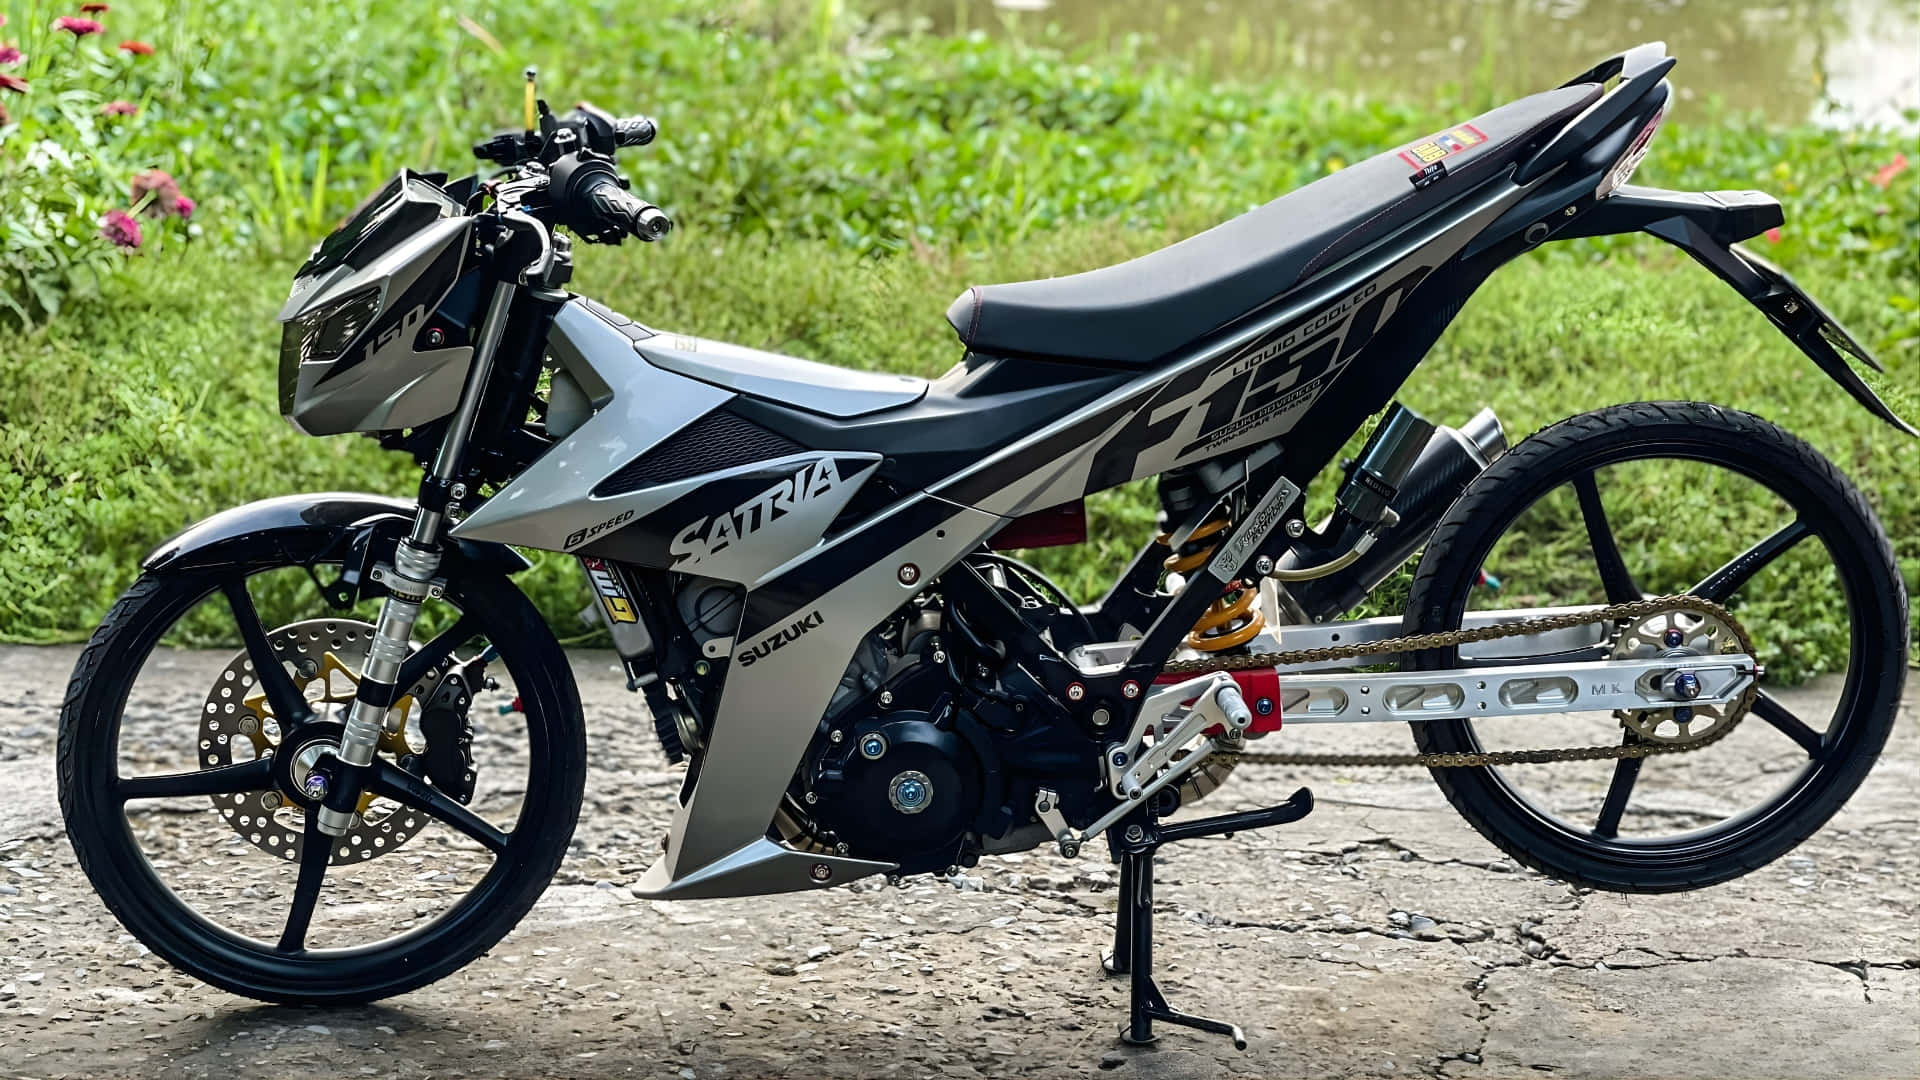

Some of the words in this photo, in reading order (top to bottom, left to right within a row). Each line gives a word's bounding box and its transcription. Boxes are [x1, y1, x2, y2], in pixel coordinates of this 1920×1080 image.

[363, 303, 426, 361] 150
[1232, 334, 1296, 376] LIQUID
[1303, 283, 1377, 337] COOLED
[1210, 413, 1257, 441] SUZUKI
[587, 509, 635, 538] SPEED
[669, 457, 842, 564] SATRIA
[737, 610, 825, 667] SUZUKI
